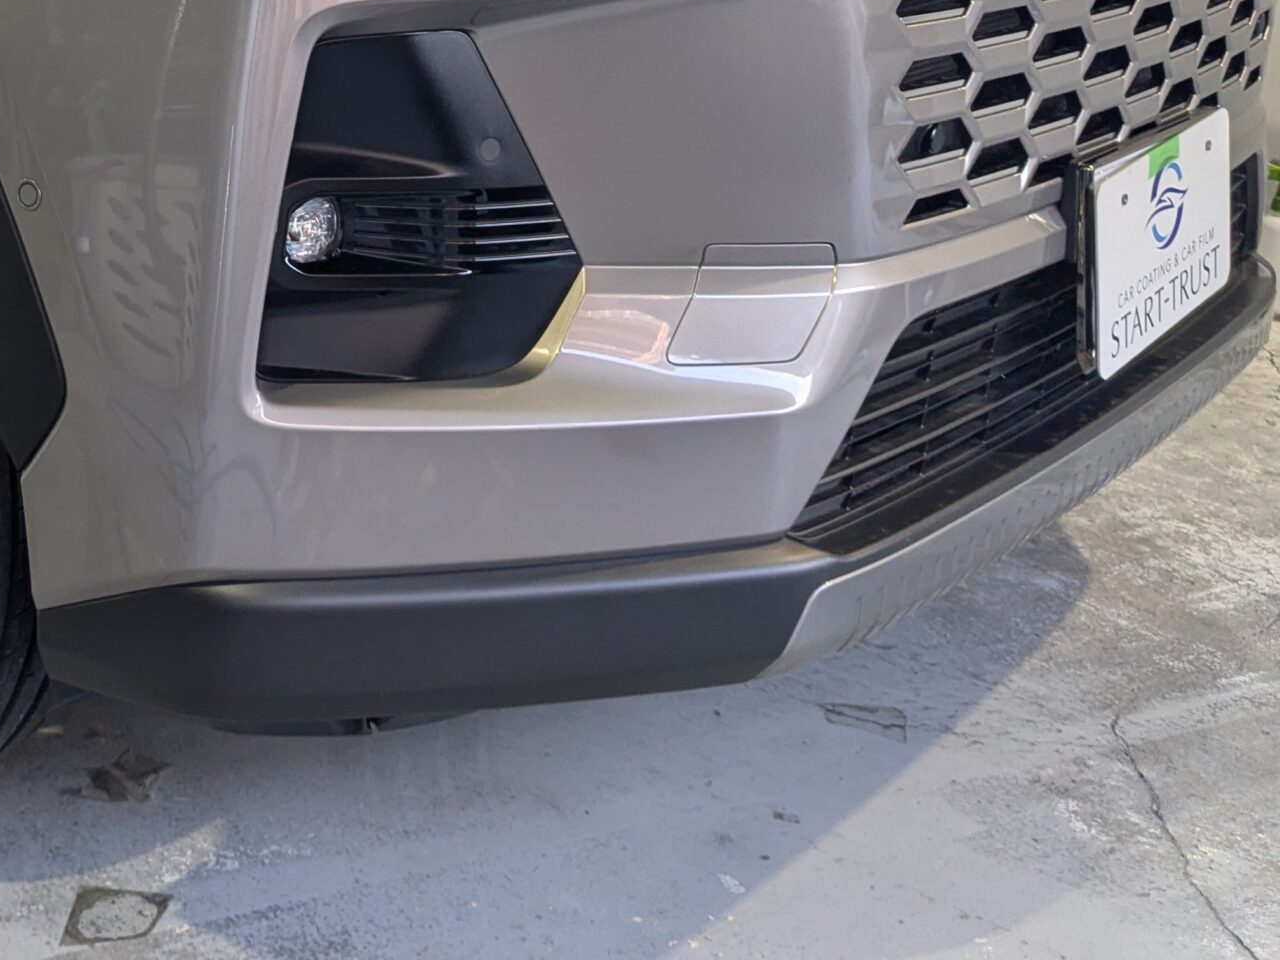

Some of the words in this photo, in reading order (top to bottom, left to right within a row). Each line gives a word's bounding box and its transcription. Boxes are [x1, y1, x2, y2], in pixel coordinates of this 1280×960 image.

[1111, 244, 1220, 359] START-TRUST
[1117, 285, 1134, 309] CAR
[1136, 258, 1171, 294] COATING
[1173, 252, 1180, 268] &
[1181, 239, 1196, 262] CAR
[1198, 226, 1215, 249] FILM
